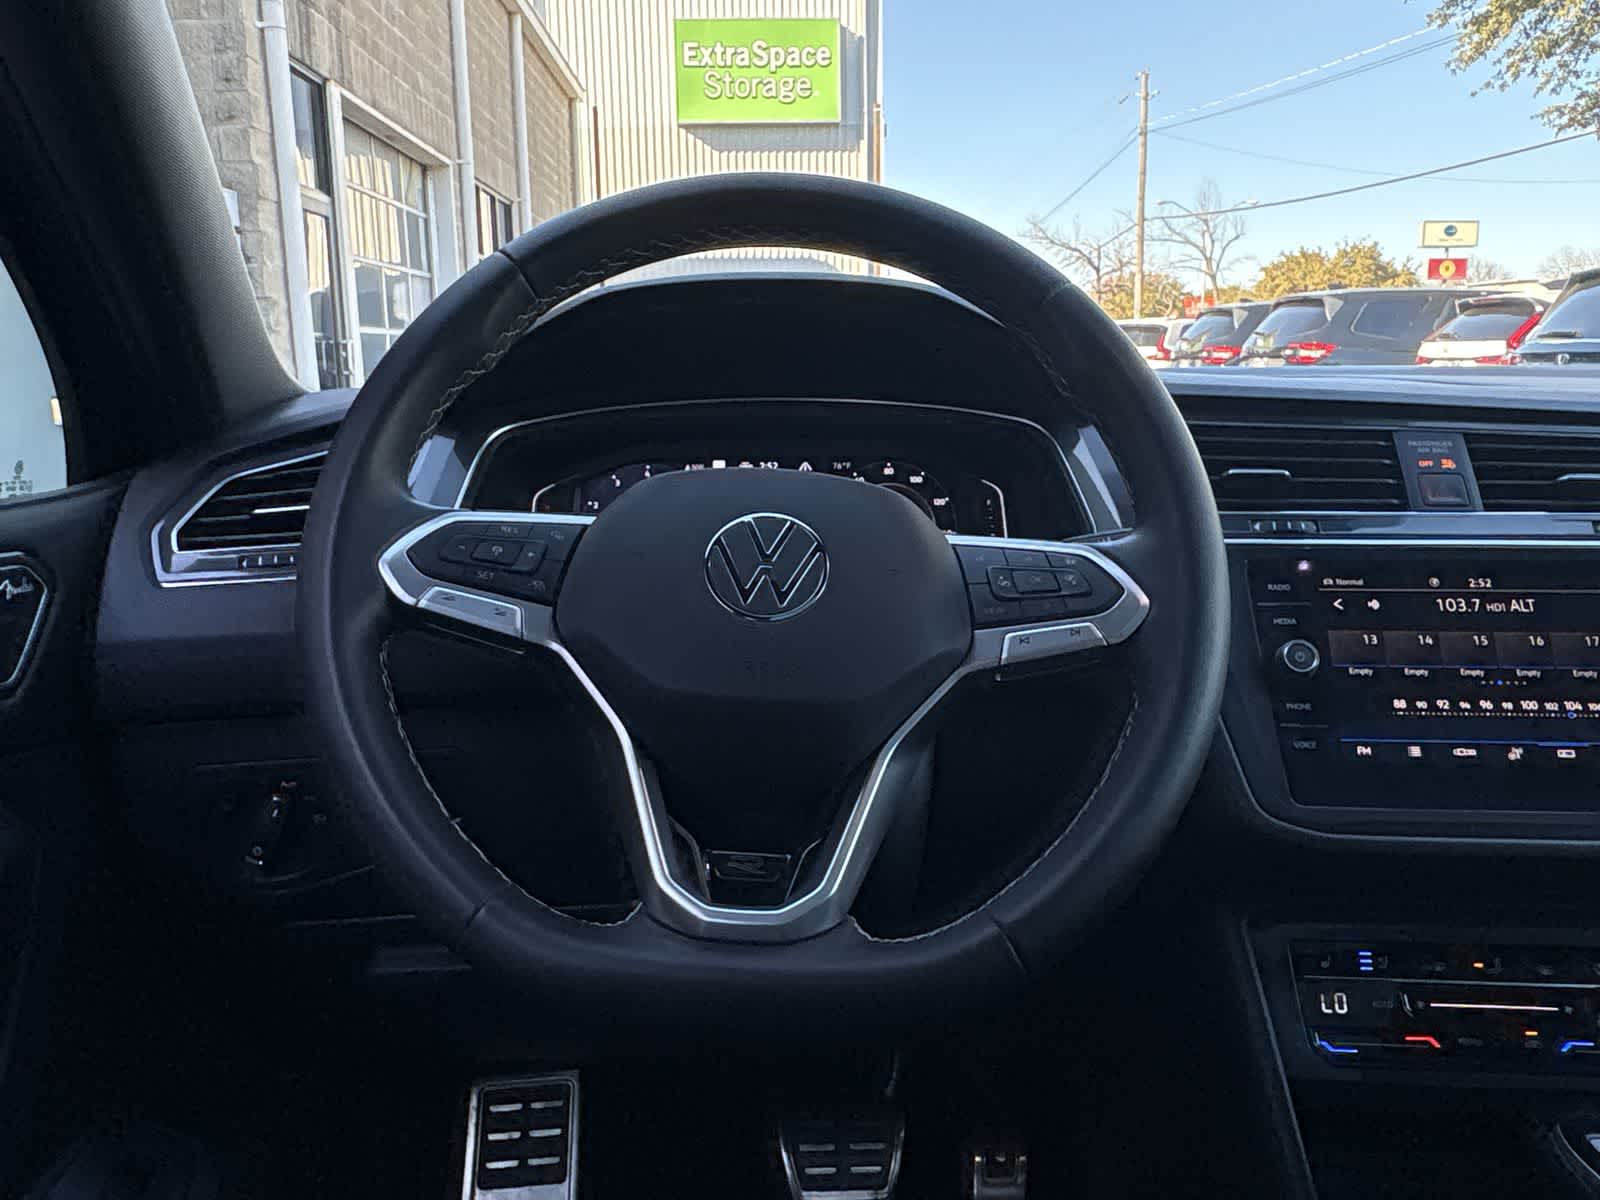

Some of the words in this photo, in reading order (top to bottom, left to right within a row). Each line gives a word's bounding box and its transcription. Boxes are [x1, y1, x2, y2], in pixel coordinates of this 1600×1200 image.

[703, 71, 813, 104] Storage
[1335, 577, 1364, 586] Normal
[1468, 578, 1492, 588] 2:52
[1267, 583, 1291, 591] RADIO
[1436, 598, 1480, 612] 103.7
[1510, 599, 1535, 612] ALT
[1273, 617, 1297, 625] MEDIA
[1363, 634, 1378, 645] 13
[1418, 635, 1433, 645] 14
[1473, 635, 1489, 646] 15
[1529, 635, 1545, 646] 16
[1585, 636, 1600, 647] 17
[1348, 667, 1373, 677] Empty
[1404, 668, 1429, 677] Empty
[1460, 668, 1485, 677] Empty
[1516, 668, 1541, 678] Empty
[1572, 669, 1598, 679] Empty
[1393, 699, 1407, 709] 88
[1436, 700, 1450, 710] 92
[1479, 700, 1494, 710] 96
[1520, 701, 1538, 710] 100
[1544, 702, 1559, 711] 102
[1563, 701, 1583, 711] 104
[1356, 745, 1372, 756] FM
[1320, 992, 1348, 1014] LO
